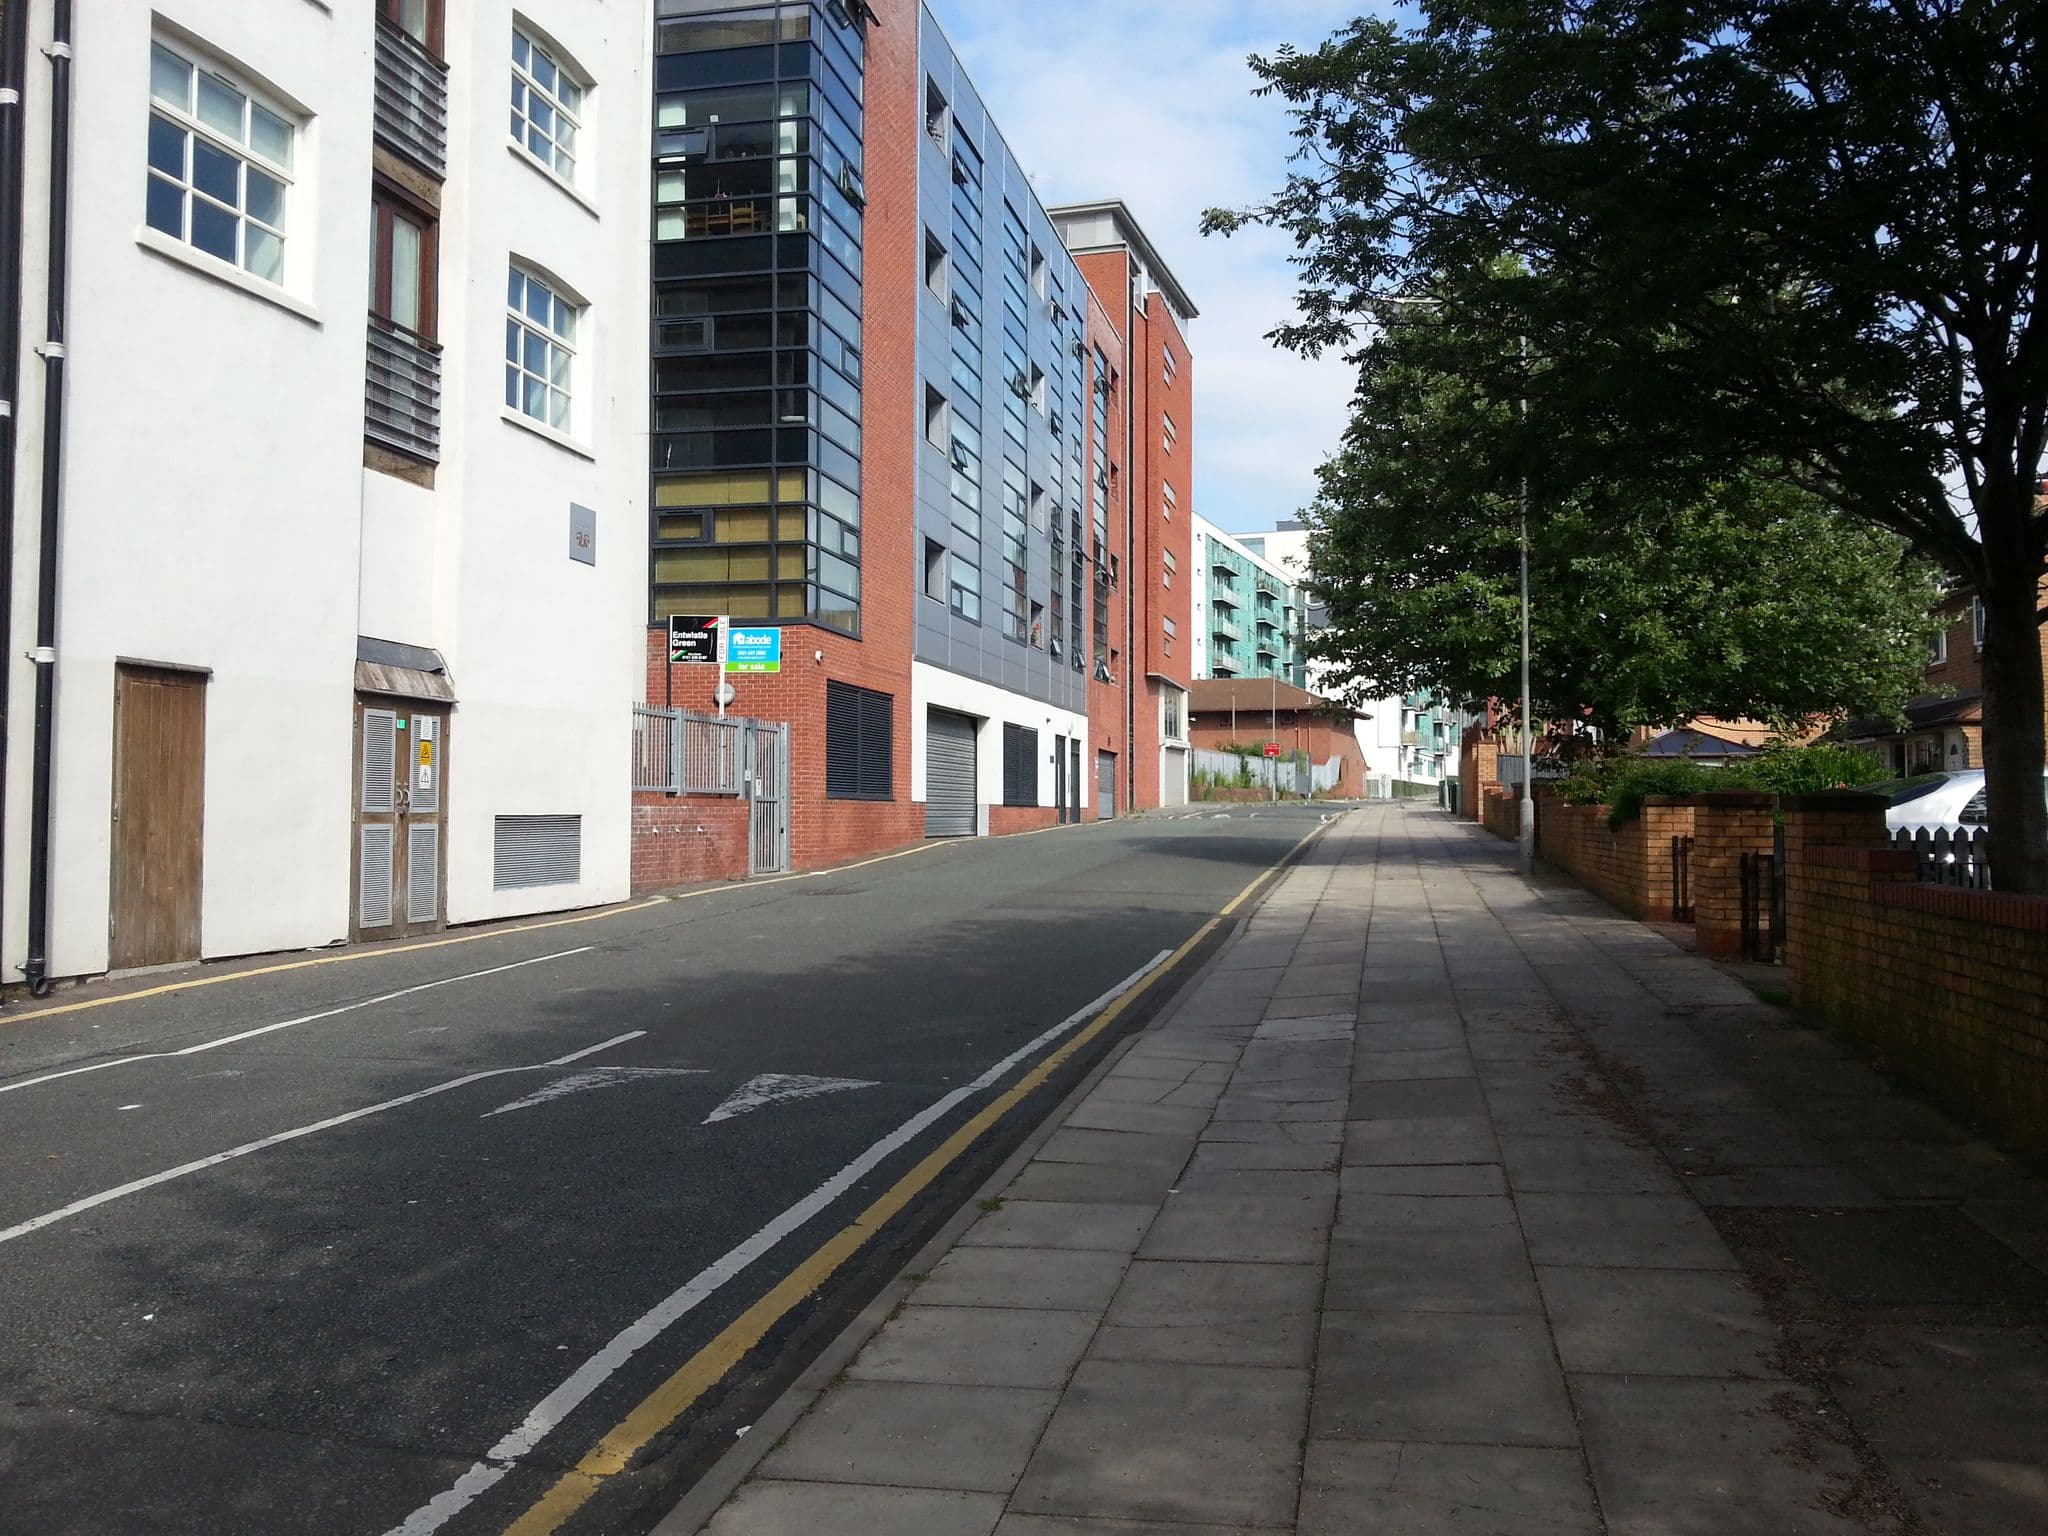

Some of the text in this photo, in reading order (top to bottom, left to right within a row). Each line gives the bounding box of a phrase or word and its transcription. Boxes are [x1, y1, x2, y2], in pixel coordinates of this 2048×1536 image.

[672, 631, 708, 639] Entwistle
[672, 639, 697, 647] Green
[745, 634, 771, 645] abode
[738, 662, 765, 670] for sale
